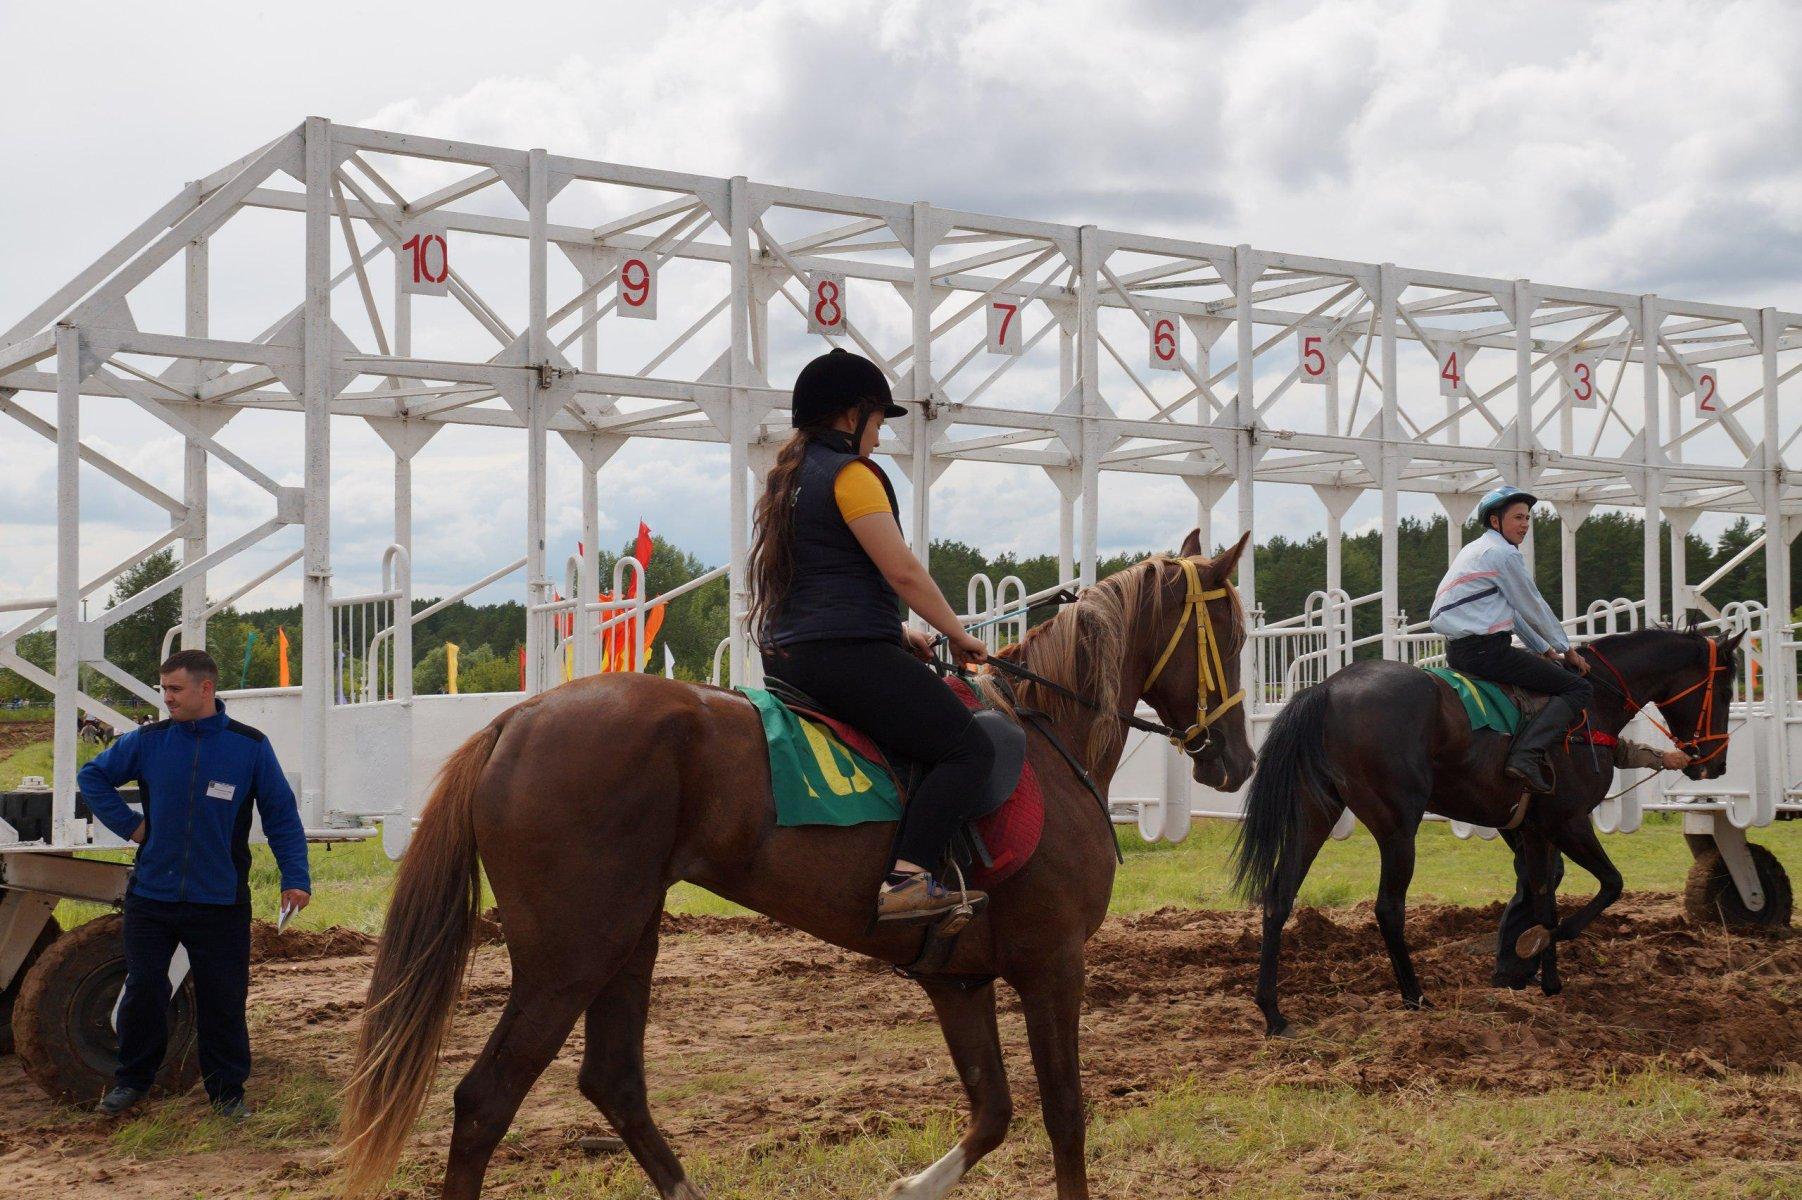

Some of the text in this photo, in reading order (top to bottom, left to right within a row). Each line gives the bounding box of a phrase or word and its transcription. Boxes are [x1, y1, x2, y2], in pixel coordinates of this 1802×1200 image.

[402, 233, 449, 283] 10
[621, 259, 649, 307] 9
[815, 280, 841, 327] 8
[993, 304, 1018, 345] 7
[1155, 320, 1176, 361] 6
[1304, 337, 1325, 376] 5
[1442, 353, 1460, 388] 4
[1575, 364, 1592, 401] 3
[1701, 375, 1716, 411] 2
